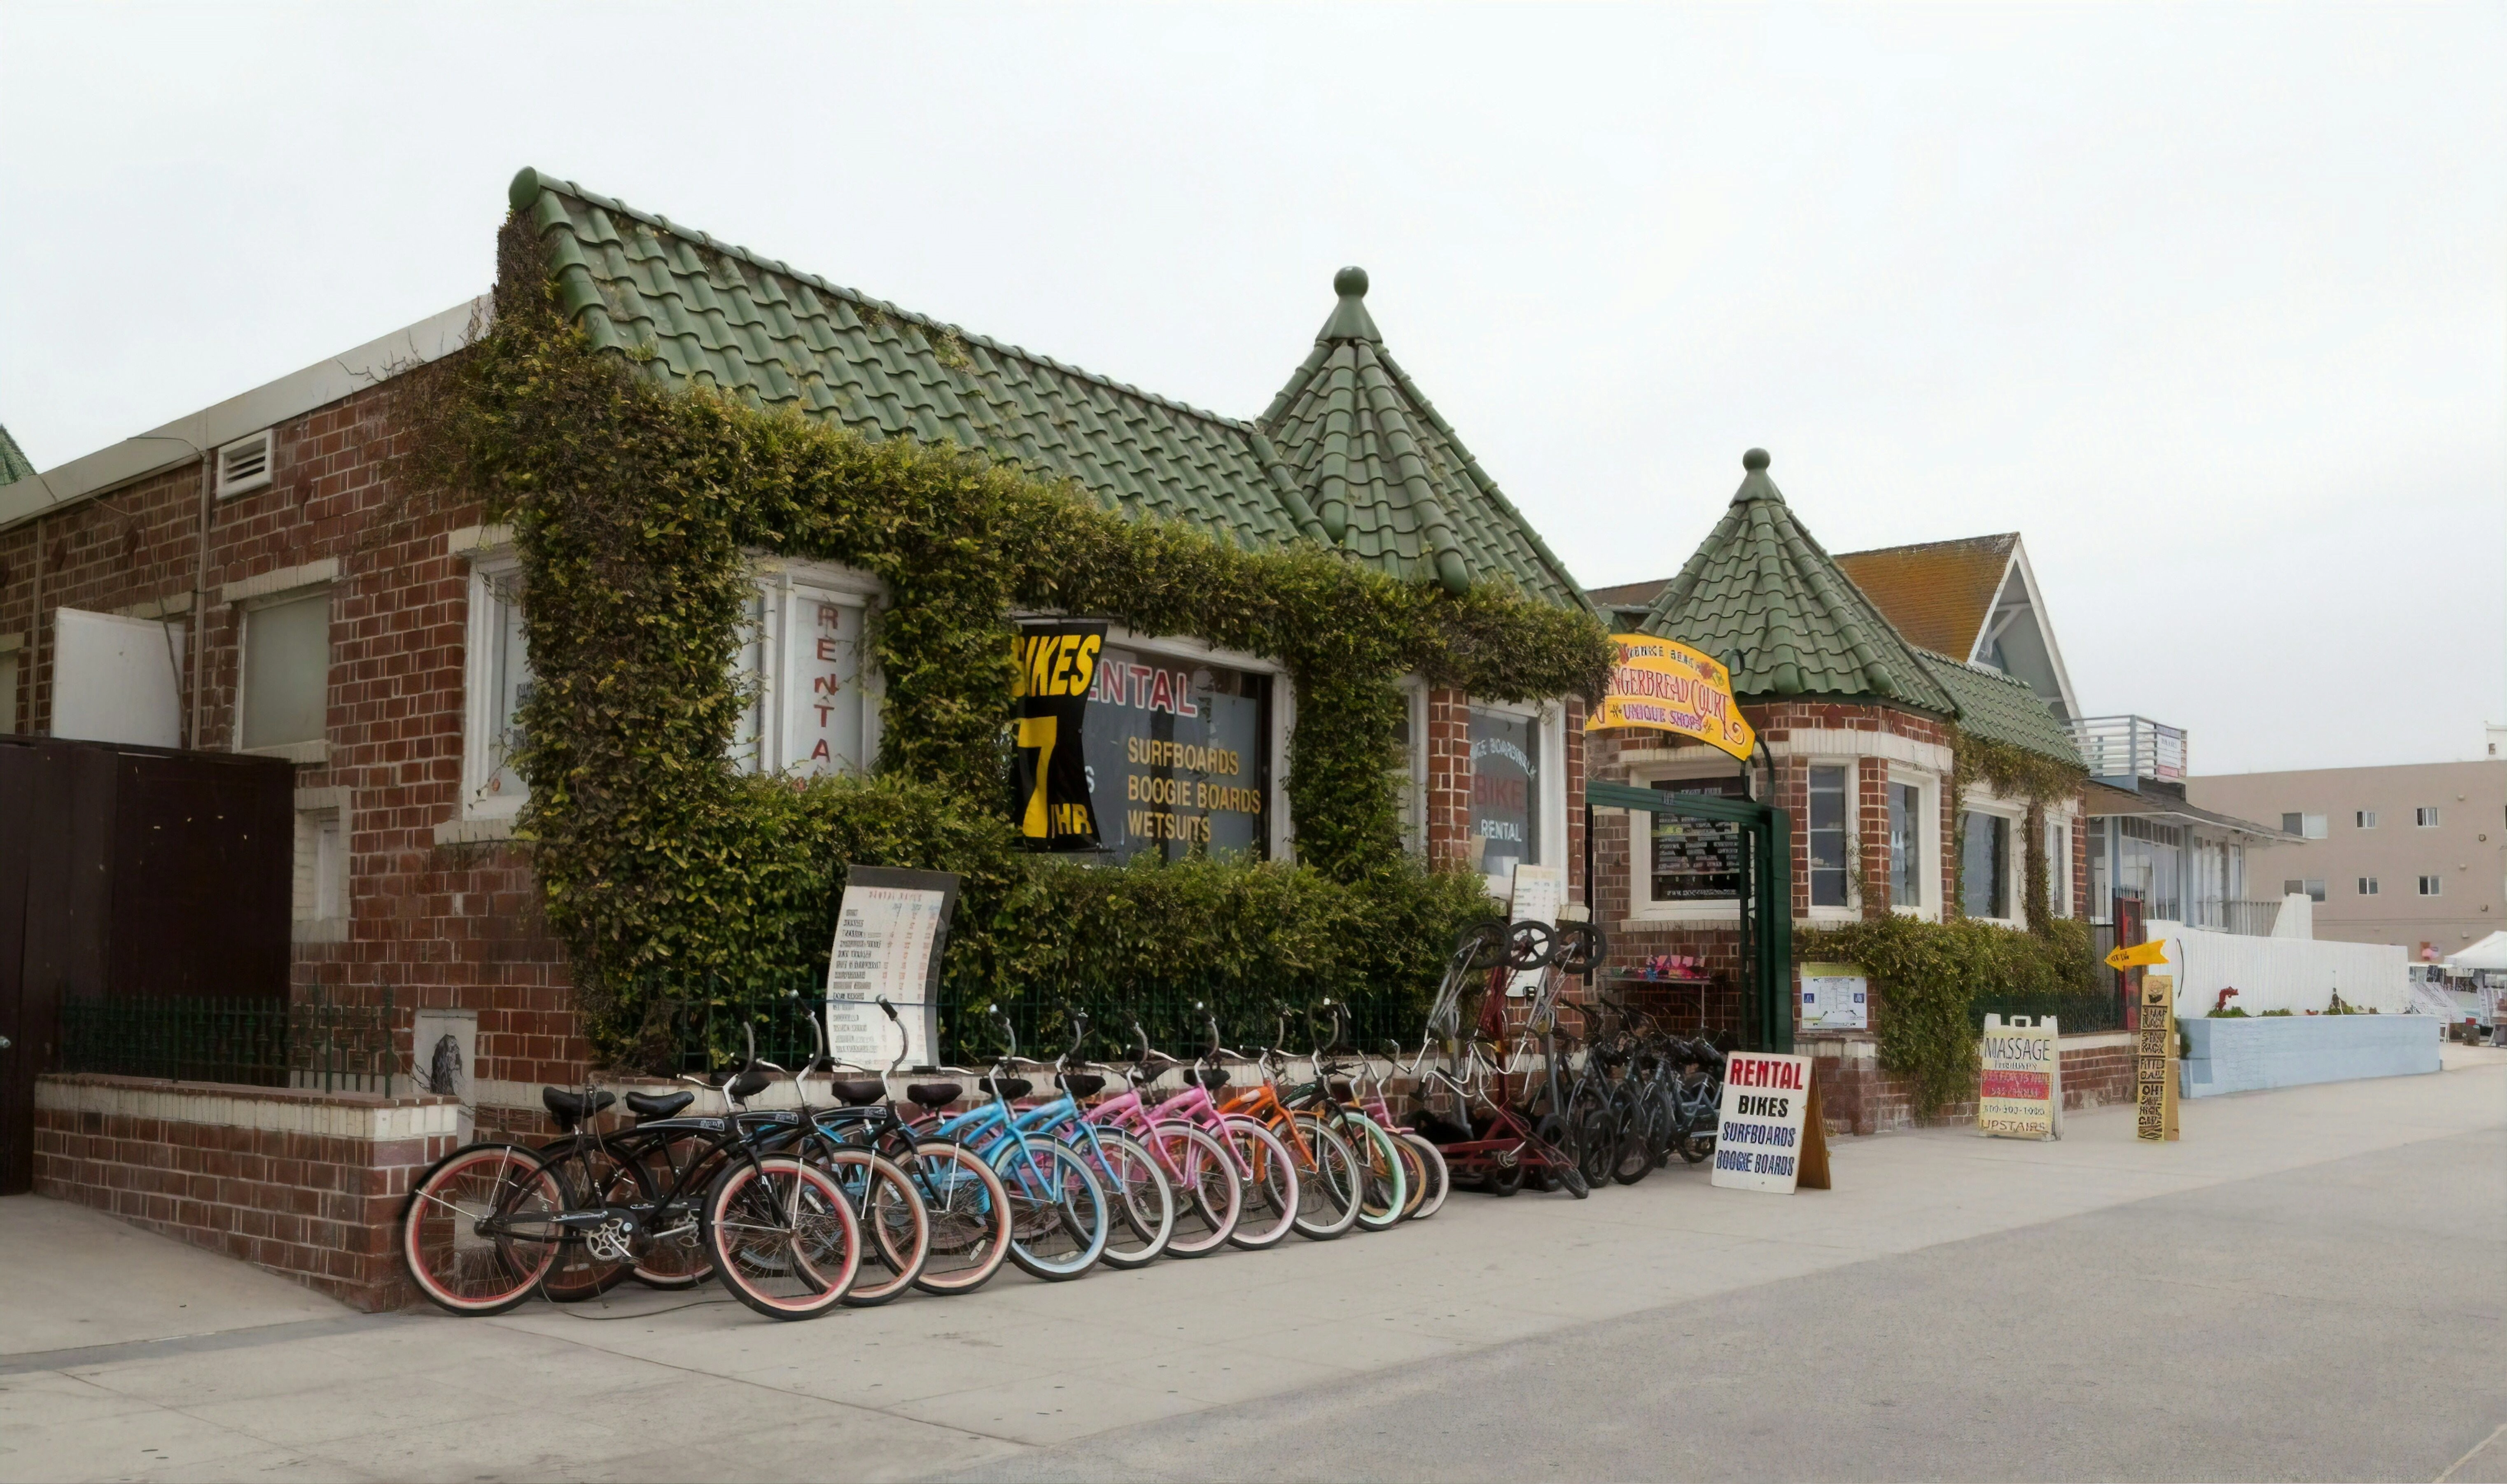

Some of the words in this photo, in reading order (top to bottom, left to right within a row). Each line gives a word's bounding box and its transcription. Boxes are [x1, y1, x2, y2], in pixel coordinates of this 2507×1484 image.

[1623, 704, 1666, 722] UNIQUE
[1669, 710, 1704, 731] SHOPS
[1127, 736, 1239, 775] SURFBOARDS
[1128, 775, 1191, 806] BOOGIE
[1197, 782, 1261, 814] BOARDS
[1475, 773, 1525, 813] BIKE
[1127, 809, 1211, 843] WETSUITS
[1481, 819, 1522, 842] RENTAL
[1984, 1037, 2051, 1061] MASSAGE
[1729, 1059, 1803, 1090] RENTAL
[1737, 1095, 1789, 1118] BIKES
[1722, 1121, 1796, 1148] SURFBOARDS
[1981, 1119, 2047, 1132] UPSTAIRS
[1716, 1149, 1753, 1172] BOOGIE
[1754, 1154, 1795, 1176] BOARDS
